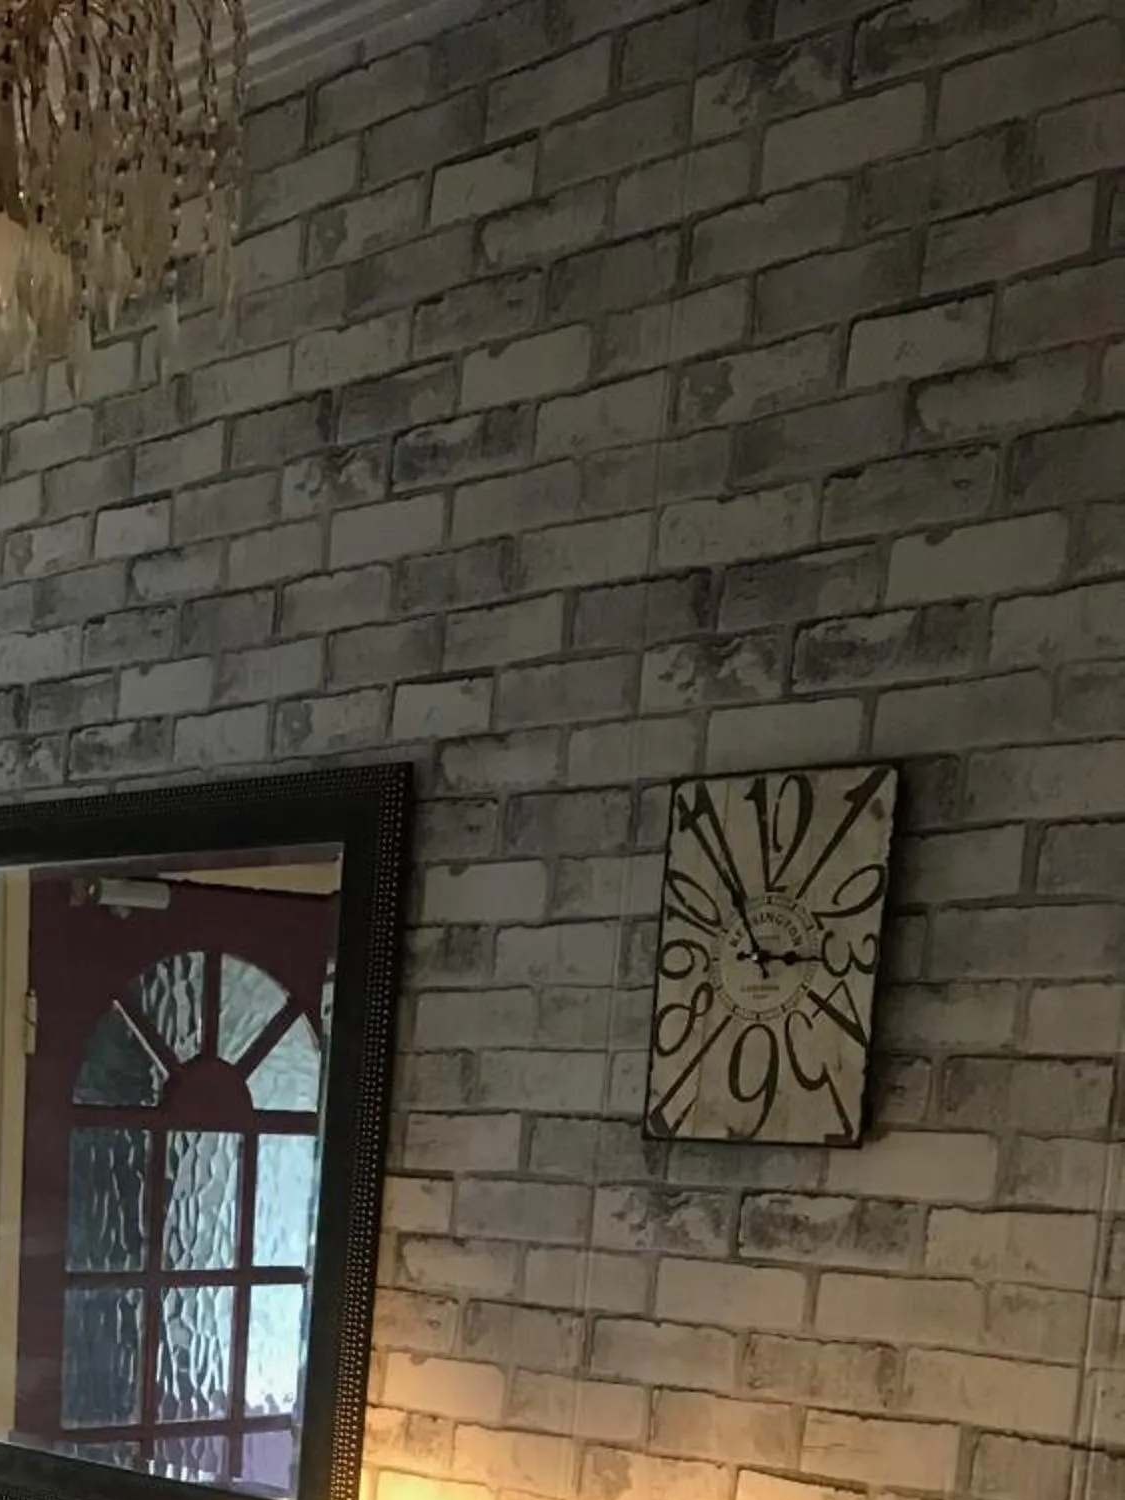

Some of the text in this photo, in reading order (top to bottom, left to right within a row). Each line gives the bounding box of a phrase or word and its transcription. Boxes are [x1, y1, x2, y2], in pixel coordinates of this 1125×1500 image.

[677, 781, 748, 901] 11
[745, 774, 813, 892] 12
[797, 768, 891, 899] 1
[666, 870, 723, 937] 10
[811, 864, 886, 930] 2
[659, 939, 710, 979] 9
[822, 930, 877, 977] 3
[655, 982, 714, 1057] 8
[807, 980, 869, 1048] 4
[650, 1016, 732, 1135] 7
[729, 1024, 779, 1138] 6
[785, 1010, 853, 1143] 5
